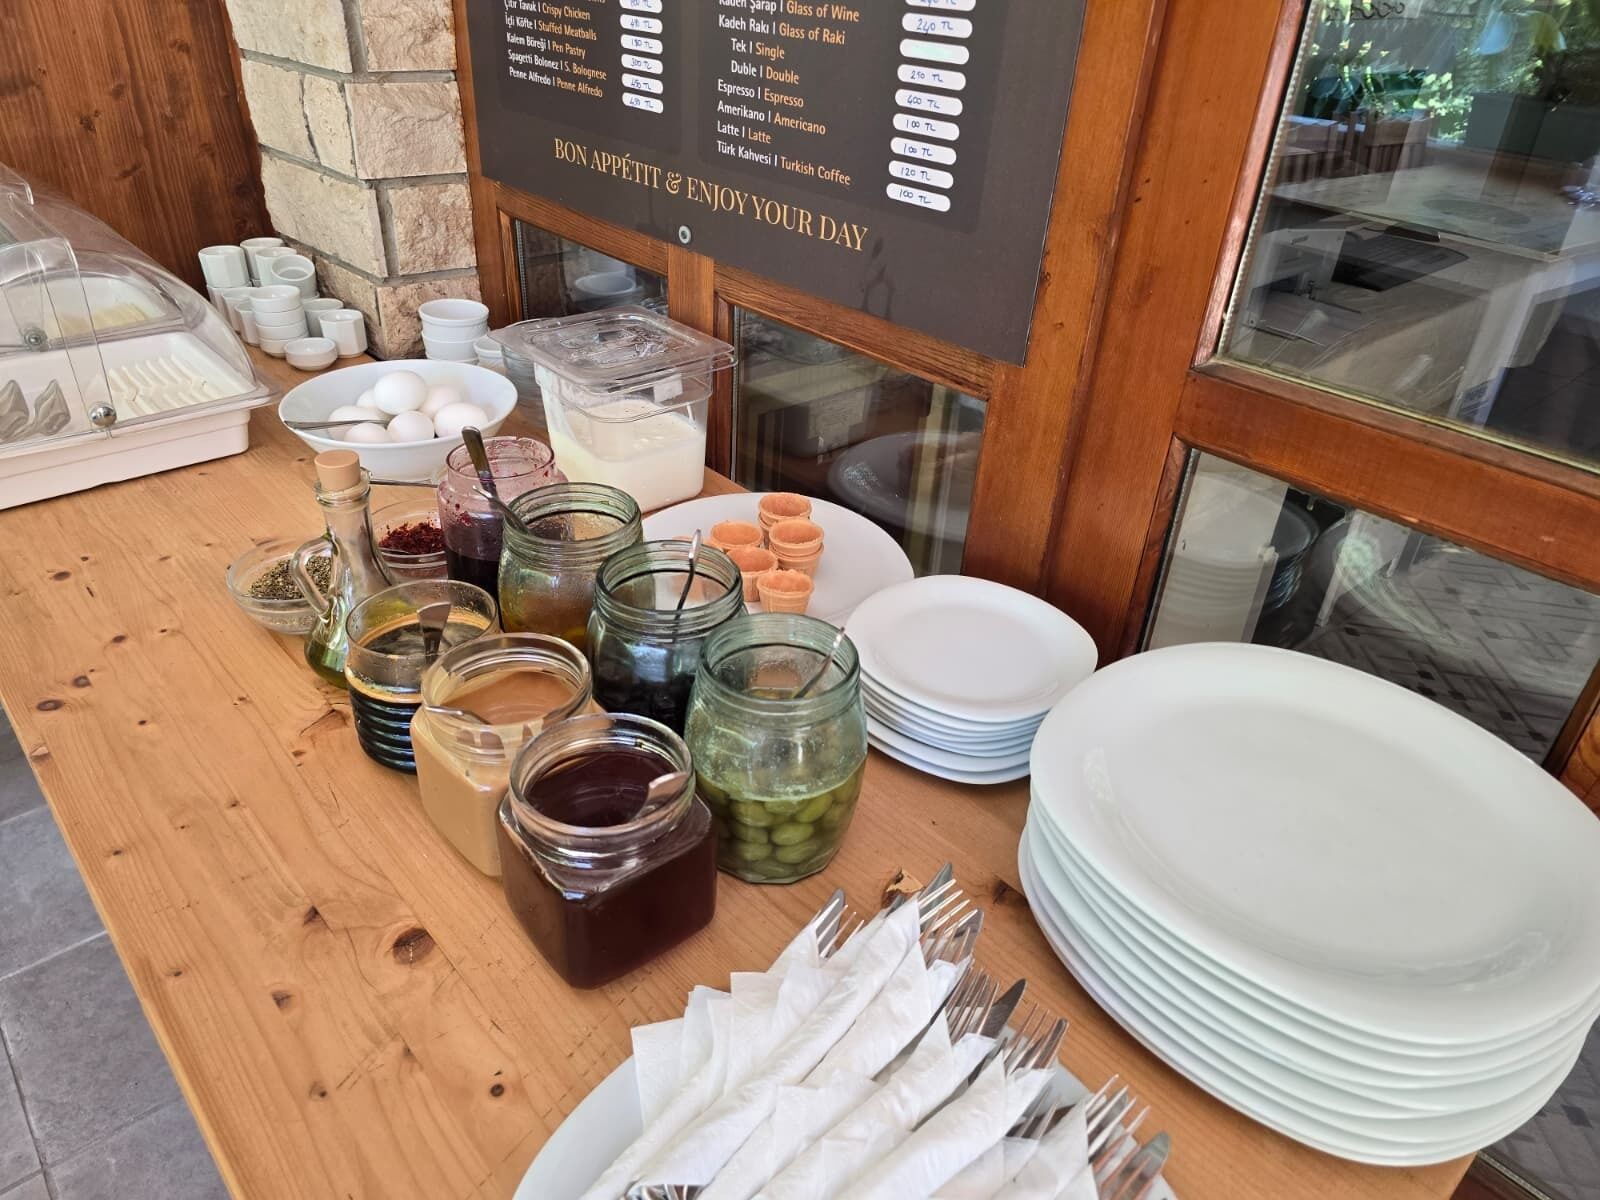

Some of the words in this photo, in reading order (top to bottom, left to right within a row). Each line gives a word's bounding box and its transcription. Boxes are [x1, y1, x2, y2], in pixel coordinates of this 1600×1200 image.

[542, 3, 562, 18] Crispy
[564, 6, 590, 20] Chicken
[786, 0, 813, 16] Glass
[816, 4, 828, 18] of
[831, 6, 860, 22] Wine
[516, 16, 533, 29] Köfte
[538, 20, 562, 34] Stuffed
[564, 24, 597, 40] Meatballs
[642, 20, 653, 28] TL
[719, 14, 746, 31] Kadeh
[779, 22, 805, 39] Glass
[808, 28, 820, 41] of
[822, 28, 846, 45] Raki
[916, 17, 936, 35] 240
[940, 20, 953, 30] TL
[506, 32, 525, 45] Kalem
[526, 34, 547, 50] Böreği
[552, 40, 564, 52] Pen
[565, 44, 586, 59] Pastry
[644, 41, 653, 49] TL
[731, 38, 746, 54] Tek
[755, 42, 785, 60] Single
[508, 50, 533, 65] Spagetti
[534, 56, 559, 70] Bolonez
[564, 62, 571, 72] S.
[572, 64, 607, 81] Bolognese
[731, 60, 757, 77] Duble
[766, 66, 800, 85] Double
[910, 70, 925, 80] 250
[932, 72, 944, 83] TL
[509, 66, 527, 79] Penne
[528, 70, 551, 86] Alfredo
[557, 77, 576, 92] Penne
[577, 80, 603, 97] Alfredo
[642, 82, 651, 90] TL
[718, 79, 755, 100] Espresso
[764, 88, 804, 108] Espresso
[906, 94, 922, 106] 400
[927, 98, 940, 108] TL
[718, 100, 765, 122] Amerikano
[774, 112, 826, 136] Americano
[905, 119, 920, 130] 100
[924, 122, 936, 132] TL
[717, 121, 740, 138] Latte
[748, 127, 771, 144] Latte
[903, 143, 918, 155] 100
[922, 146, 933, 156] TL
[717, 141, 736, 156] Türk
[738, 145, 771, 165] Kahvesi
[780, 156, 814, 176] Turkish
[817, 167, 851, 186] Coffee
[900, 166, 916, 177] 120
[920, 170, 932, 181] TL
[554, 137, 588, 166] BON
[591, 152, 662, 190] APPÉTIT
[666, 171, 682, 194] &
[686, 175, 748, 216] ENJOY
[751, 195, 814, 237] YOUR
[819, 214, 869, 252] DAY
[899, 189, 914, 200] 100
[918, 194, 932, 204] TL
